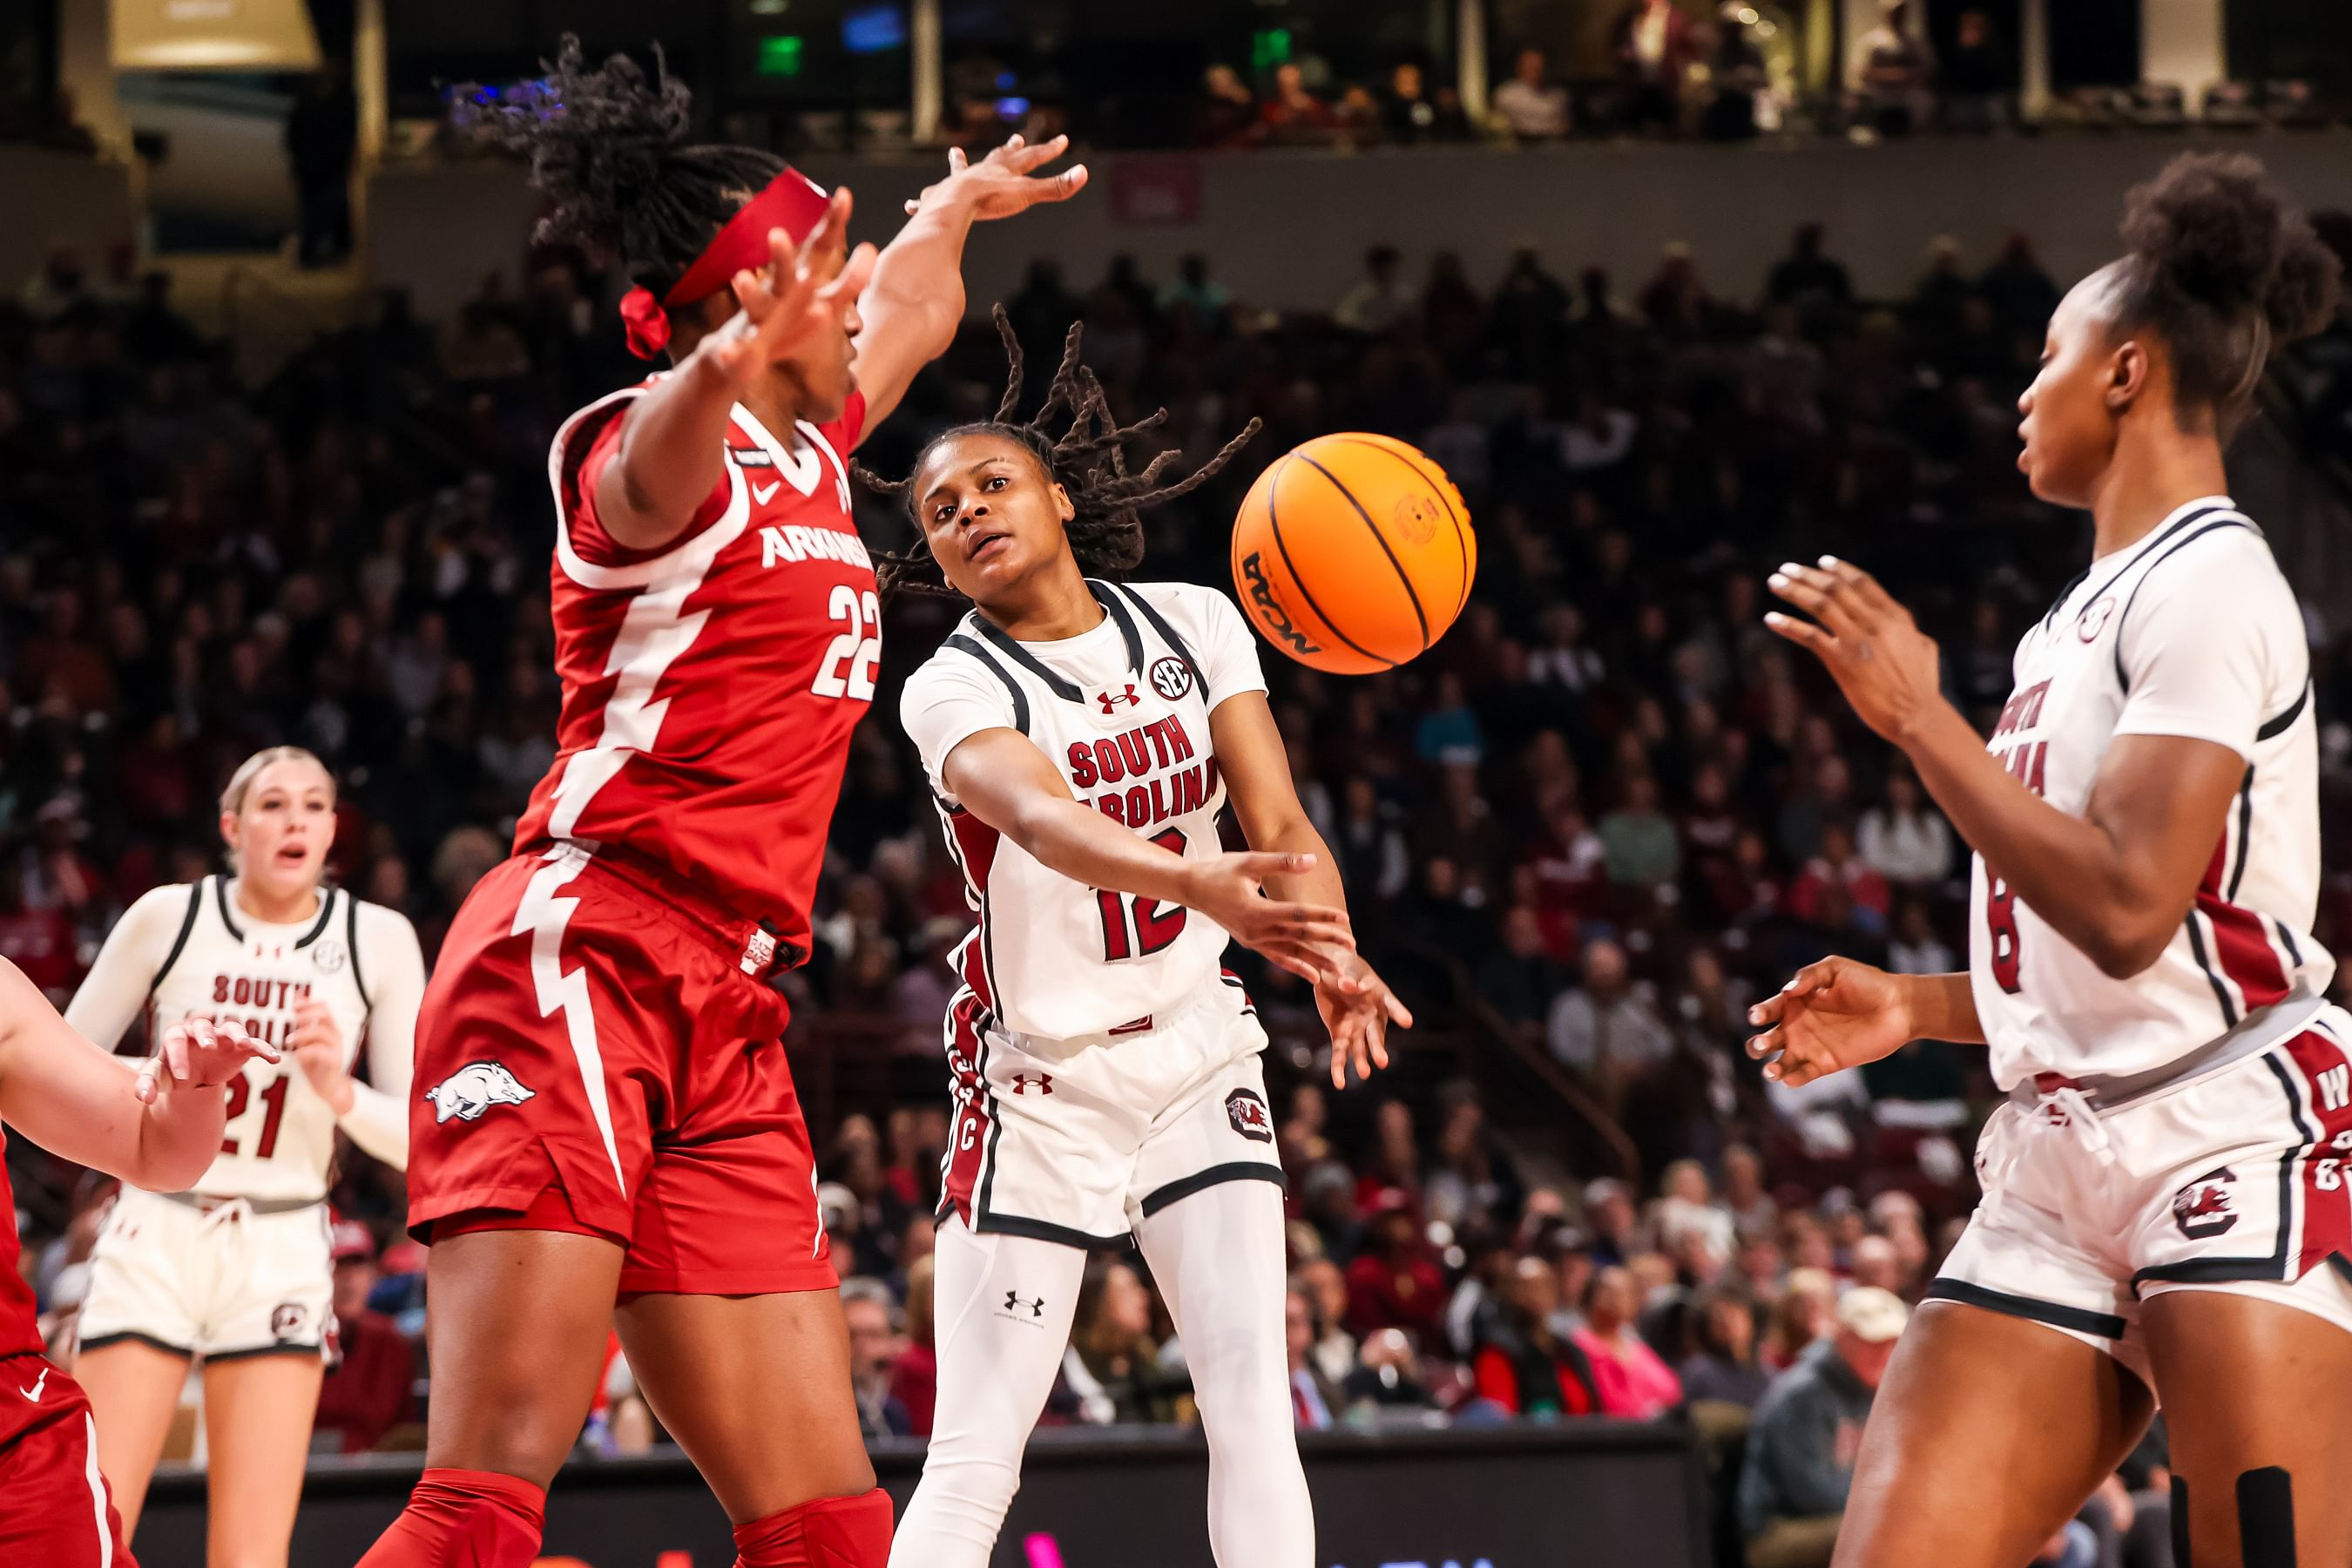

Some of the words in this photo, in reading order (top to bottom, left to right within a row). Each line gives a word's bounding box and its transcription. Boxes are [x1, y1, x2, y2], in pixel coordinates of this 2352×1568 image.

[809, 584, 883, 702] 22
[1241, 551, 1322, 655] NCAA
[1152, 658, 1191, 700] SEC
[1067, 713, 1195, 789] SOUTH
[1088, 825, 1188, 963] 12
